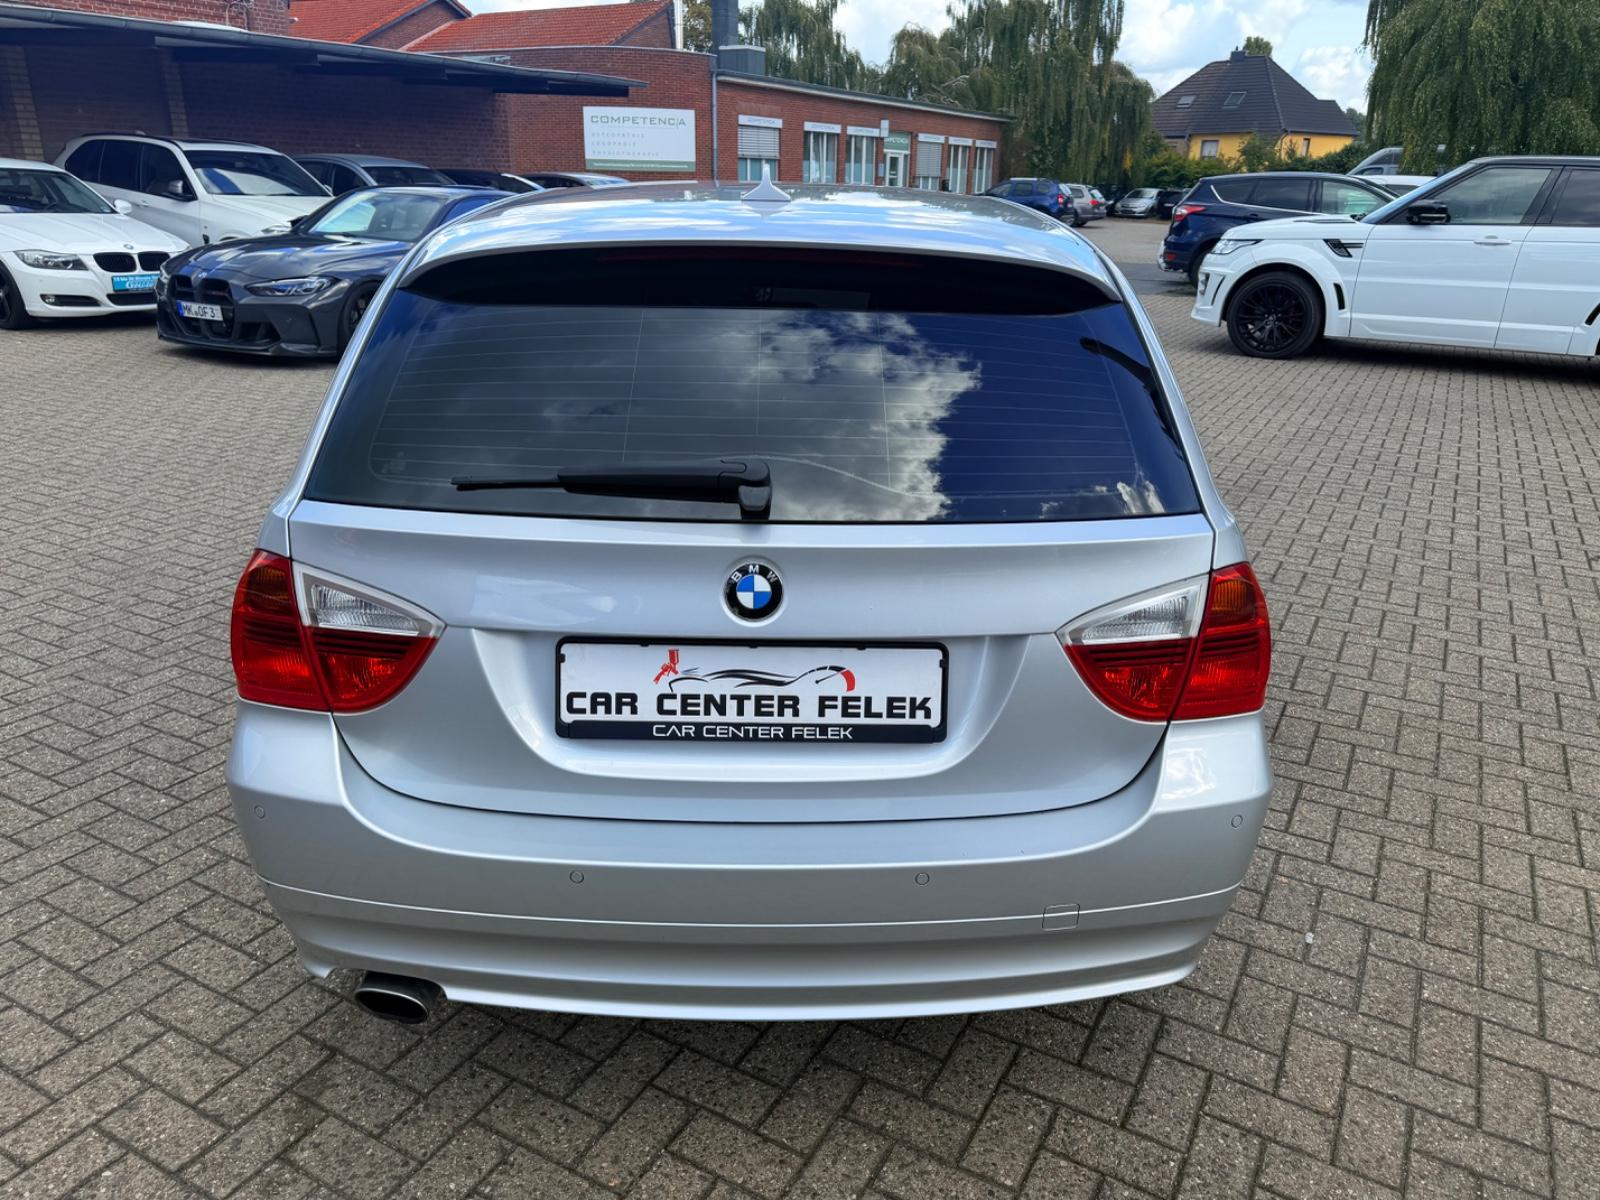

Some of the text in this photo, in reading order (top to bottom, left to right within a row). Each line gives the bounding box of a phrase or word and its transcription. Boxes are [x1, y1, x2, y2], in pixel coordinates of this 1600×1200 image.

[731, 564, 778, 582] BMW
[566, 691, 932, 720] CAR CENTER FELEK
[652, 724, 853, 740] CAR CENTER FELEK
